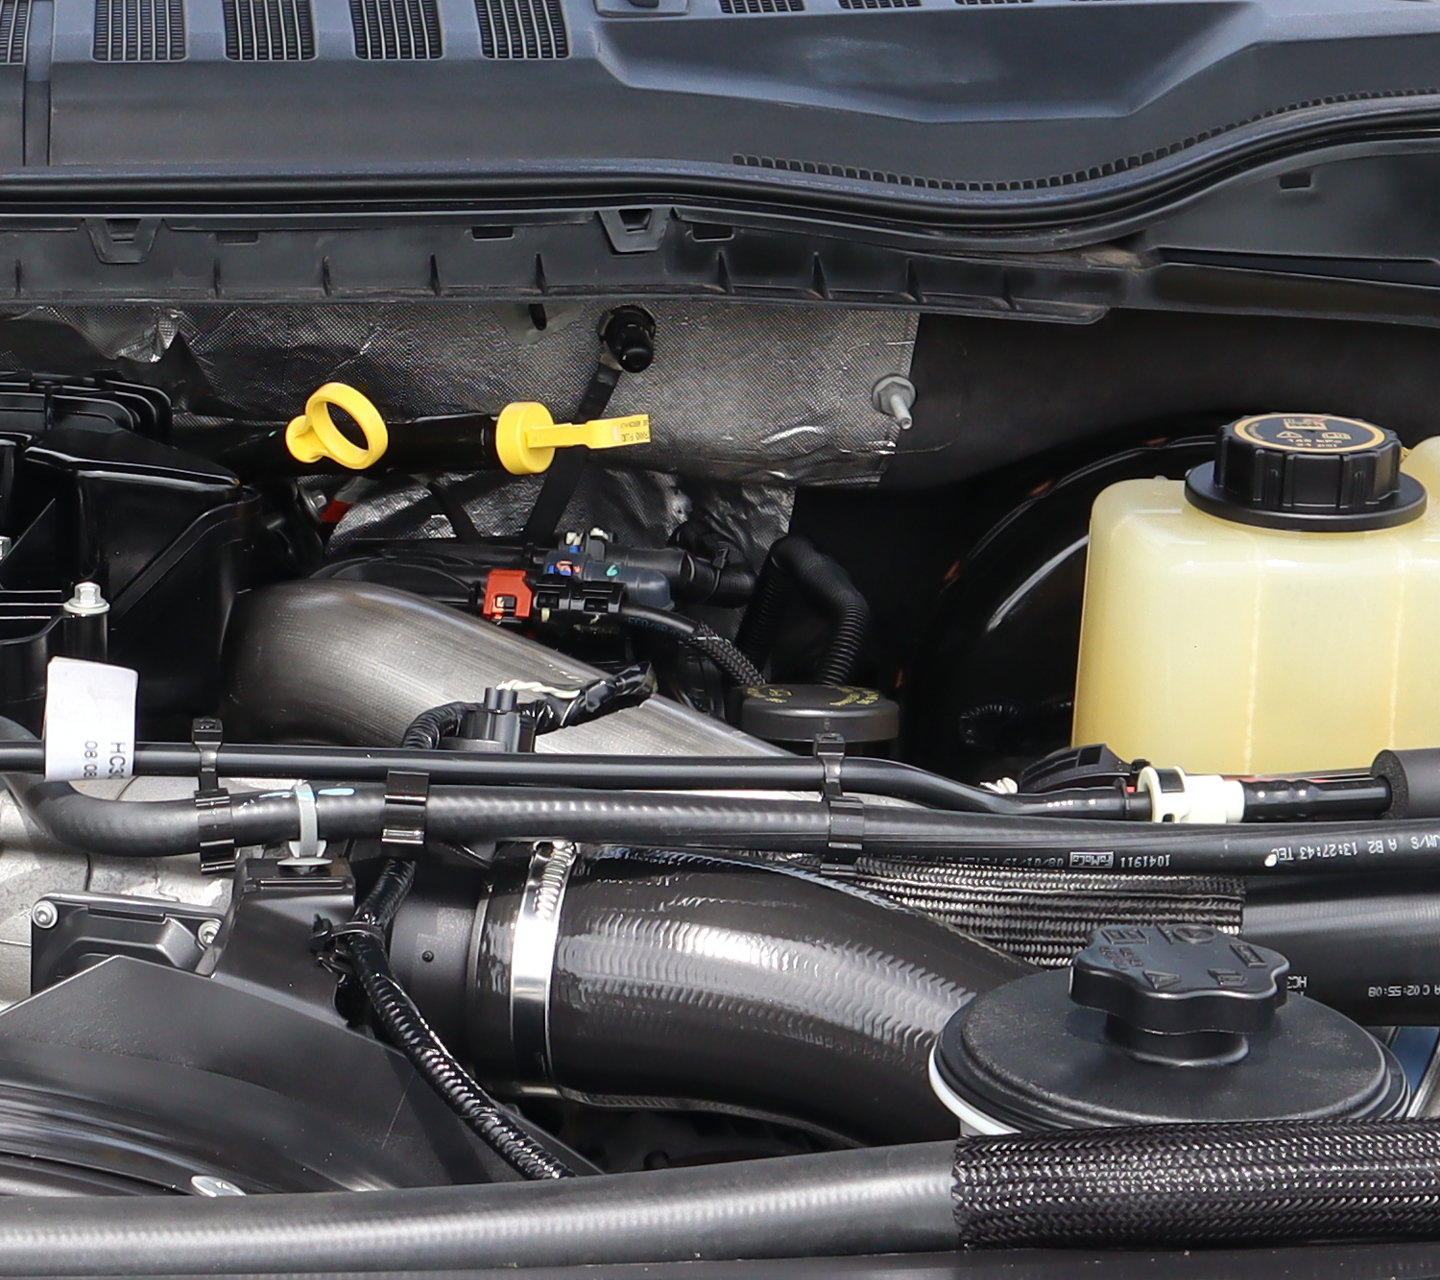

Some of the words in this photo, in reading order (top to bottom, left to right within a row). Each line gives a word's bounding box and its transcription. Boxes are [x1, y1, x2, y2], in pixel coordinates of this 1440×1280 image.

[1299, 842, 1359, 860] 13:27:43
[1071, 853, 1112, 867] FoMoCo
[1120, 853, 1171, 868] 1041911
